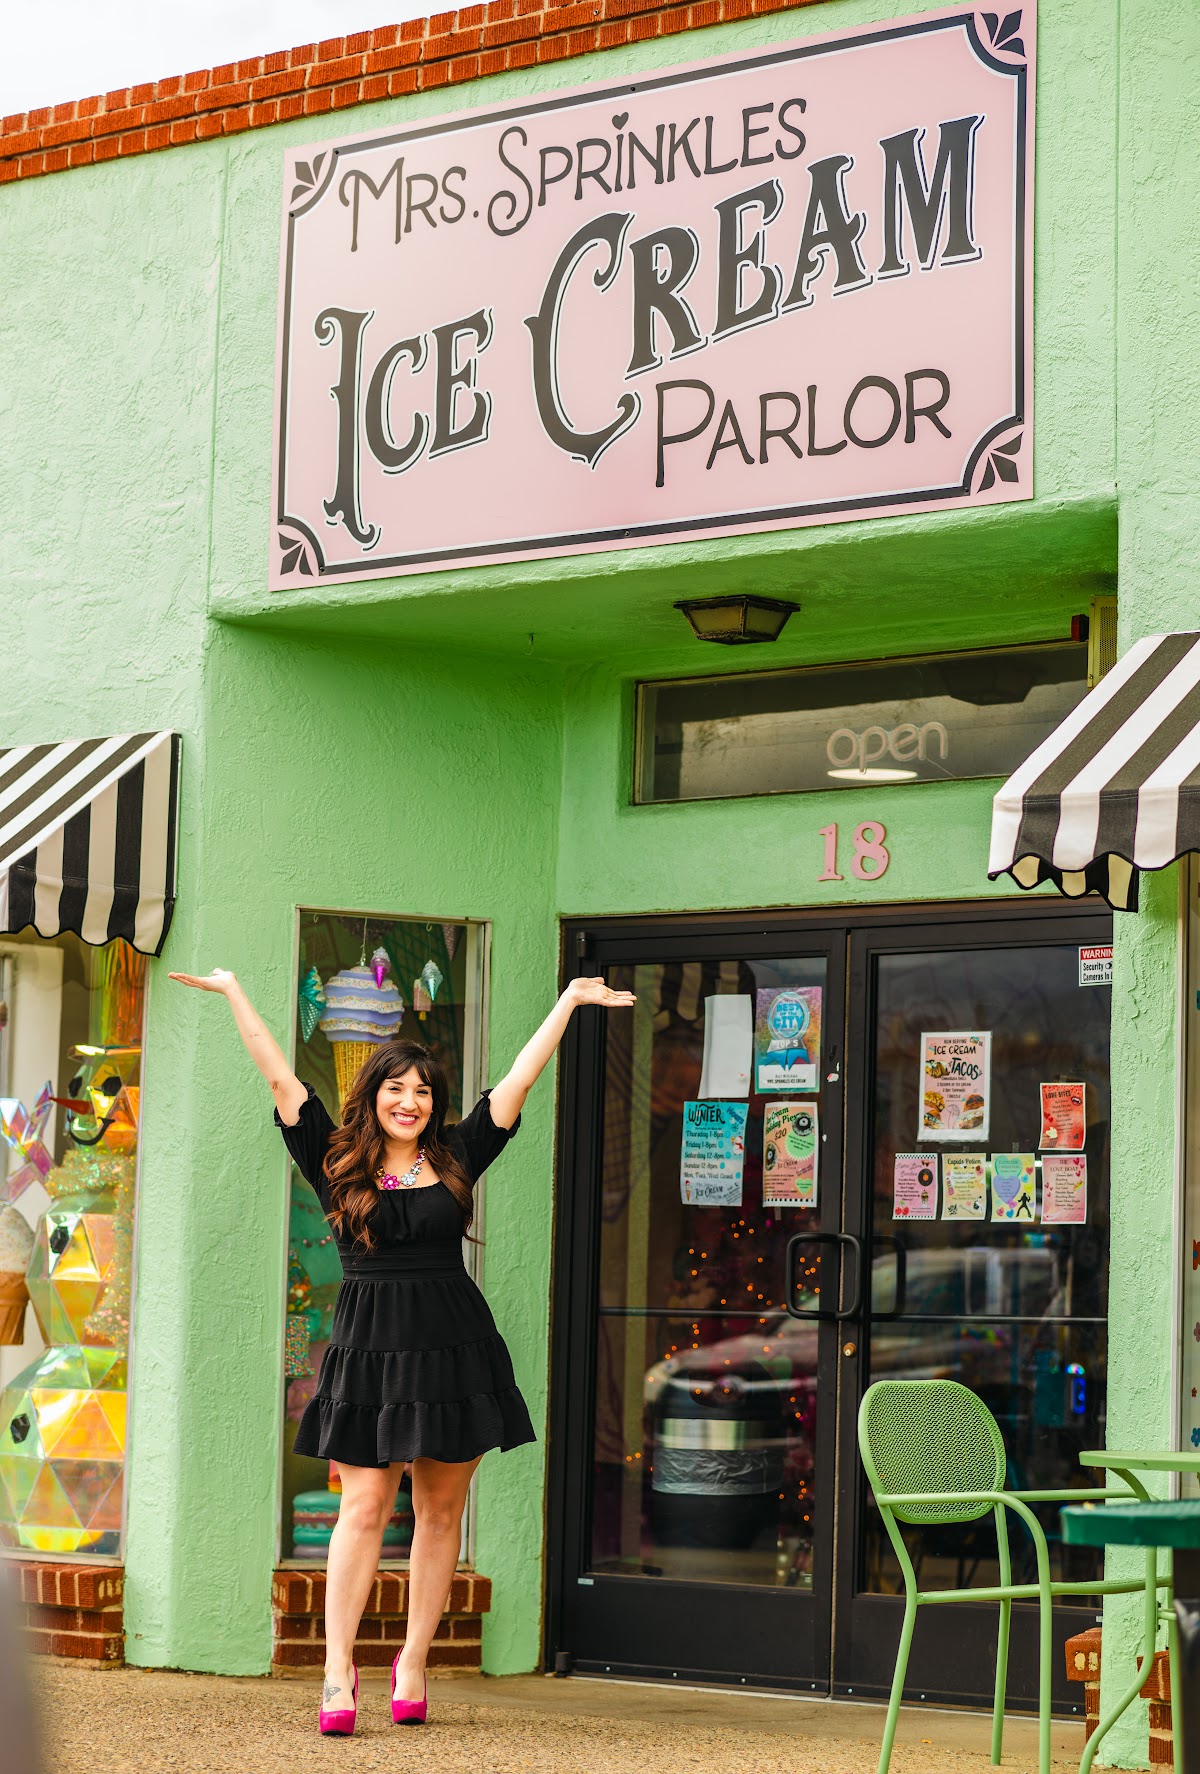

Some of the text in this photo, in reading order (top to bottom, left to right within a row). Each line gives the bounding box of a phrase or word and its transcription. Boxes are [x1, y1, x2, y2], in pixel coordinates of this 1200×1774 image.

[339, 98, 807, 252] MRS. SPRINKLES
[314, 114, 985, 551] ICE CREAM
[655, 369, 953, 487] PARLOR
[826, 721, 948, 774] open
[816, 821, 891, 882] 18
[1082, 948, 1113, 959] WARNIN
[1083, 962, 1104, 972] Security
[1083, 973, 1104, 981] Cameras
[776, 1003, 800, 1012] BEST
[773, 1016, 804, 1029] CITY
[776, 1040, 799, 1049] TOP 5
[934, 1045, 976, 1055] ICE CREAM
[951, 1057, 978, 1080] TACOS
[688, 1104, 726, 1126] WINTER
[772, 1107, 789, 1120] Cream
[782, 1114, 797, 1124] Pies
[686, 1130, 708, 1139] Thursday
[686, 1141, 700, 1149] Friday
[684, 1152, 706, 1160] Saturday
